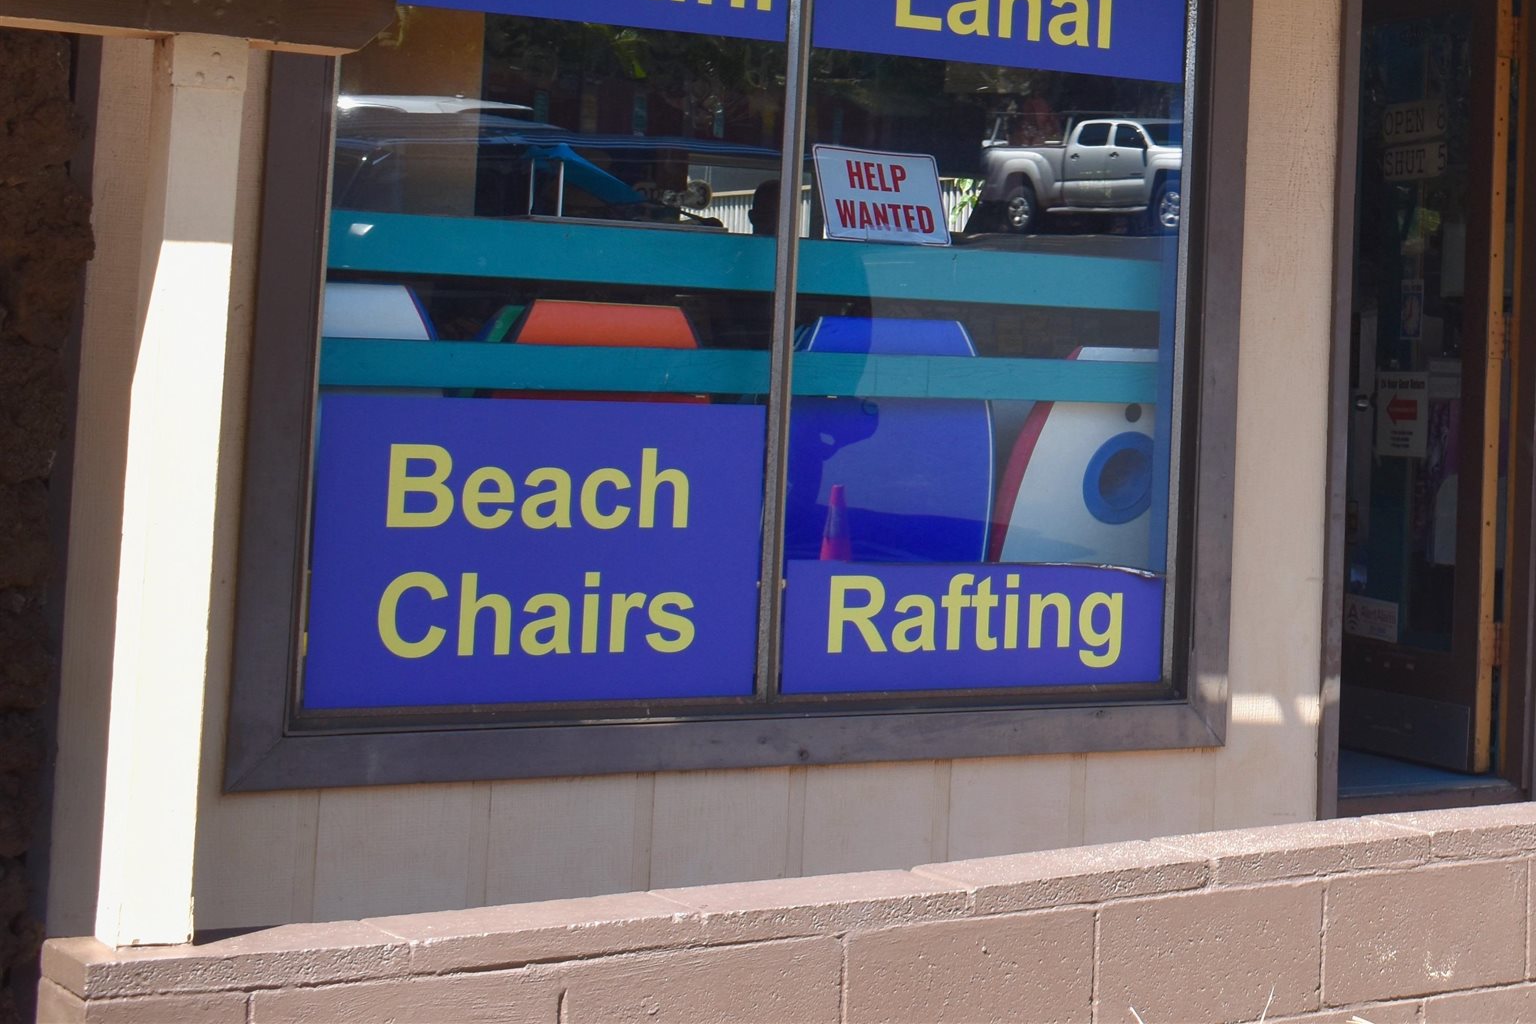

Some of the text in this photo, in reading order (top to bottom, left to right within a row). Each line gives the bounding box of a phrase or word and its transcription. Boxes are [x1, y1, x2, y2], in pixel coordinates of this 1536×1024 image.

[1384, 107, 1425, 136] OPEN
[846, 159, 907, 193] HELP
[1384, 143, 1447, 177] SHUT 5
[835, 198, 935, 235] WANTED
[386, 444, 690, 530] Beach
[377, 572, 696, 659] Chairs
[826, 574, 1123, 668] Rafting
